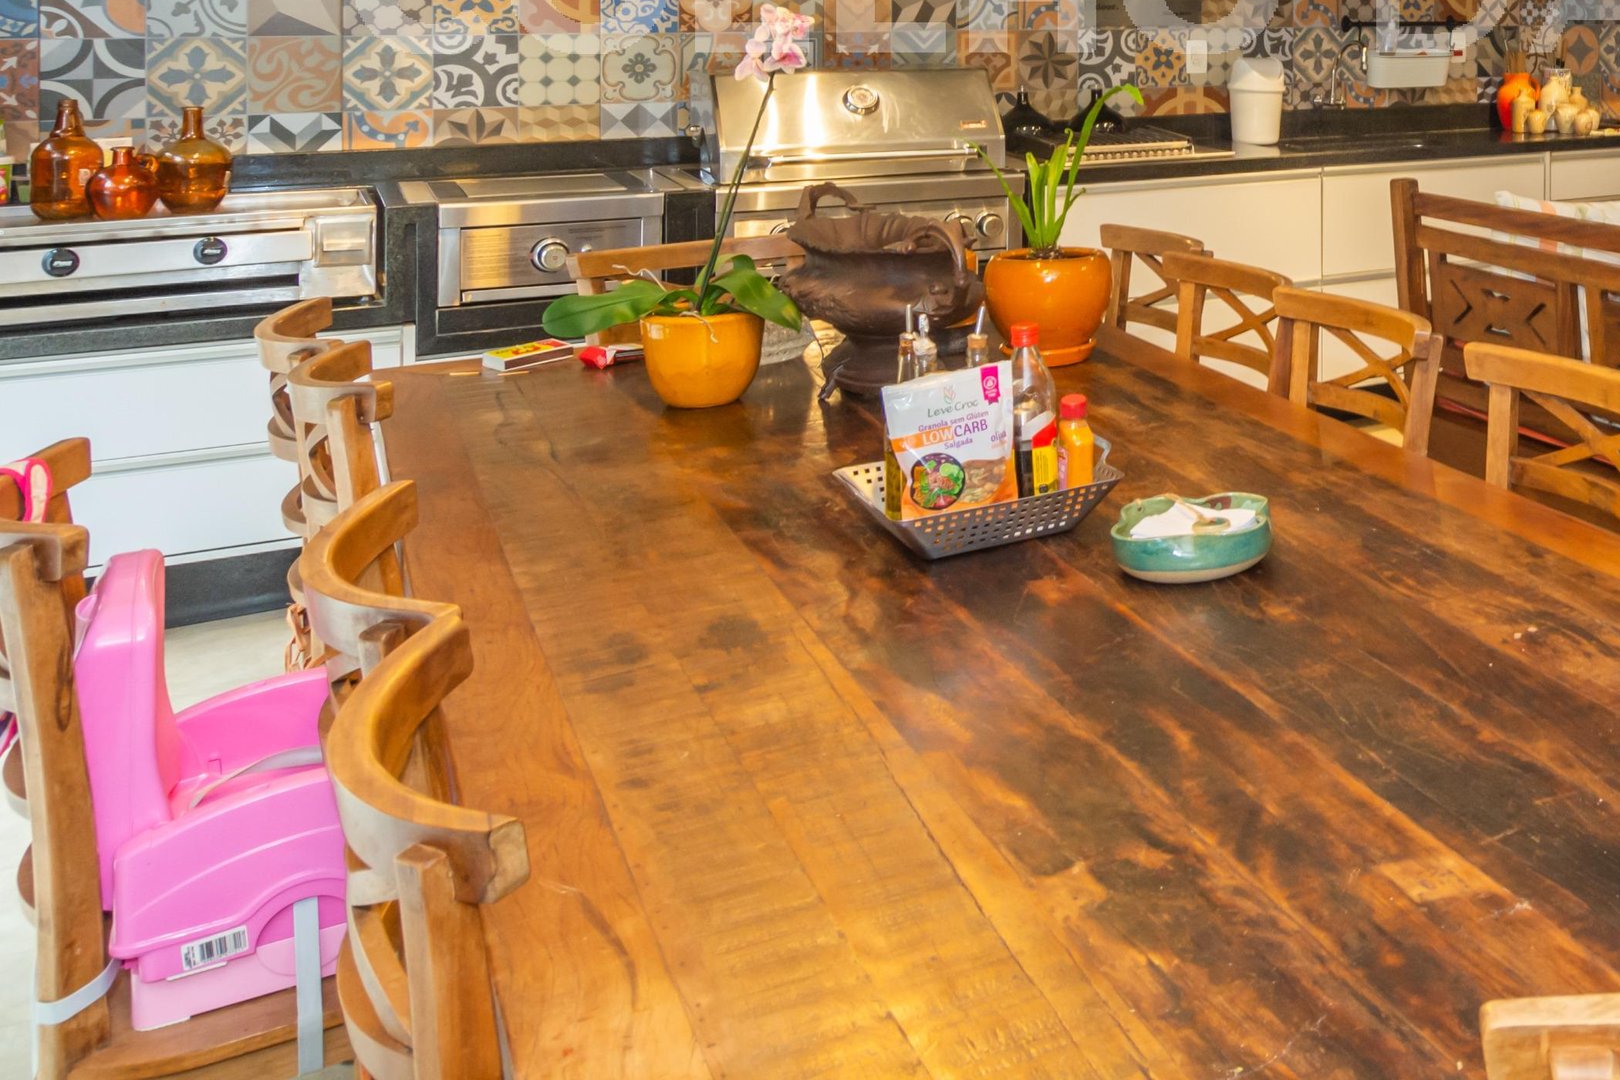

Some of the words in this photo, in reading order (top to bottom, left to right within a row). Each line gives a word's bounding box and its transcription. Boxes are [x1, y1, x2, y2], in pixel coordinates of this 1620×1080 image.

[927, 404, 953, 418] Leve
[918, 420, 949, 433] Granola
[949, 416, 965, 426] sem
[921, 428, 954, 446] LOW
[954, 418, 988, 438] CARB
[943, 437, 973, 450] Salgada
